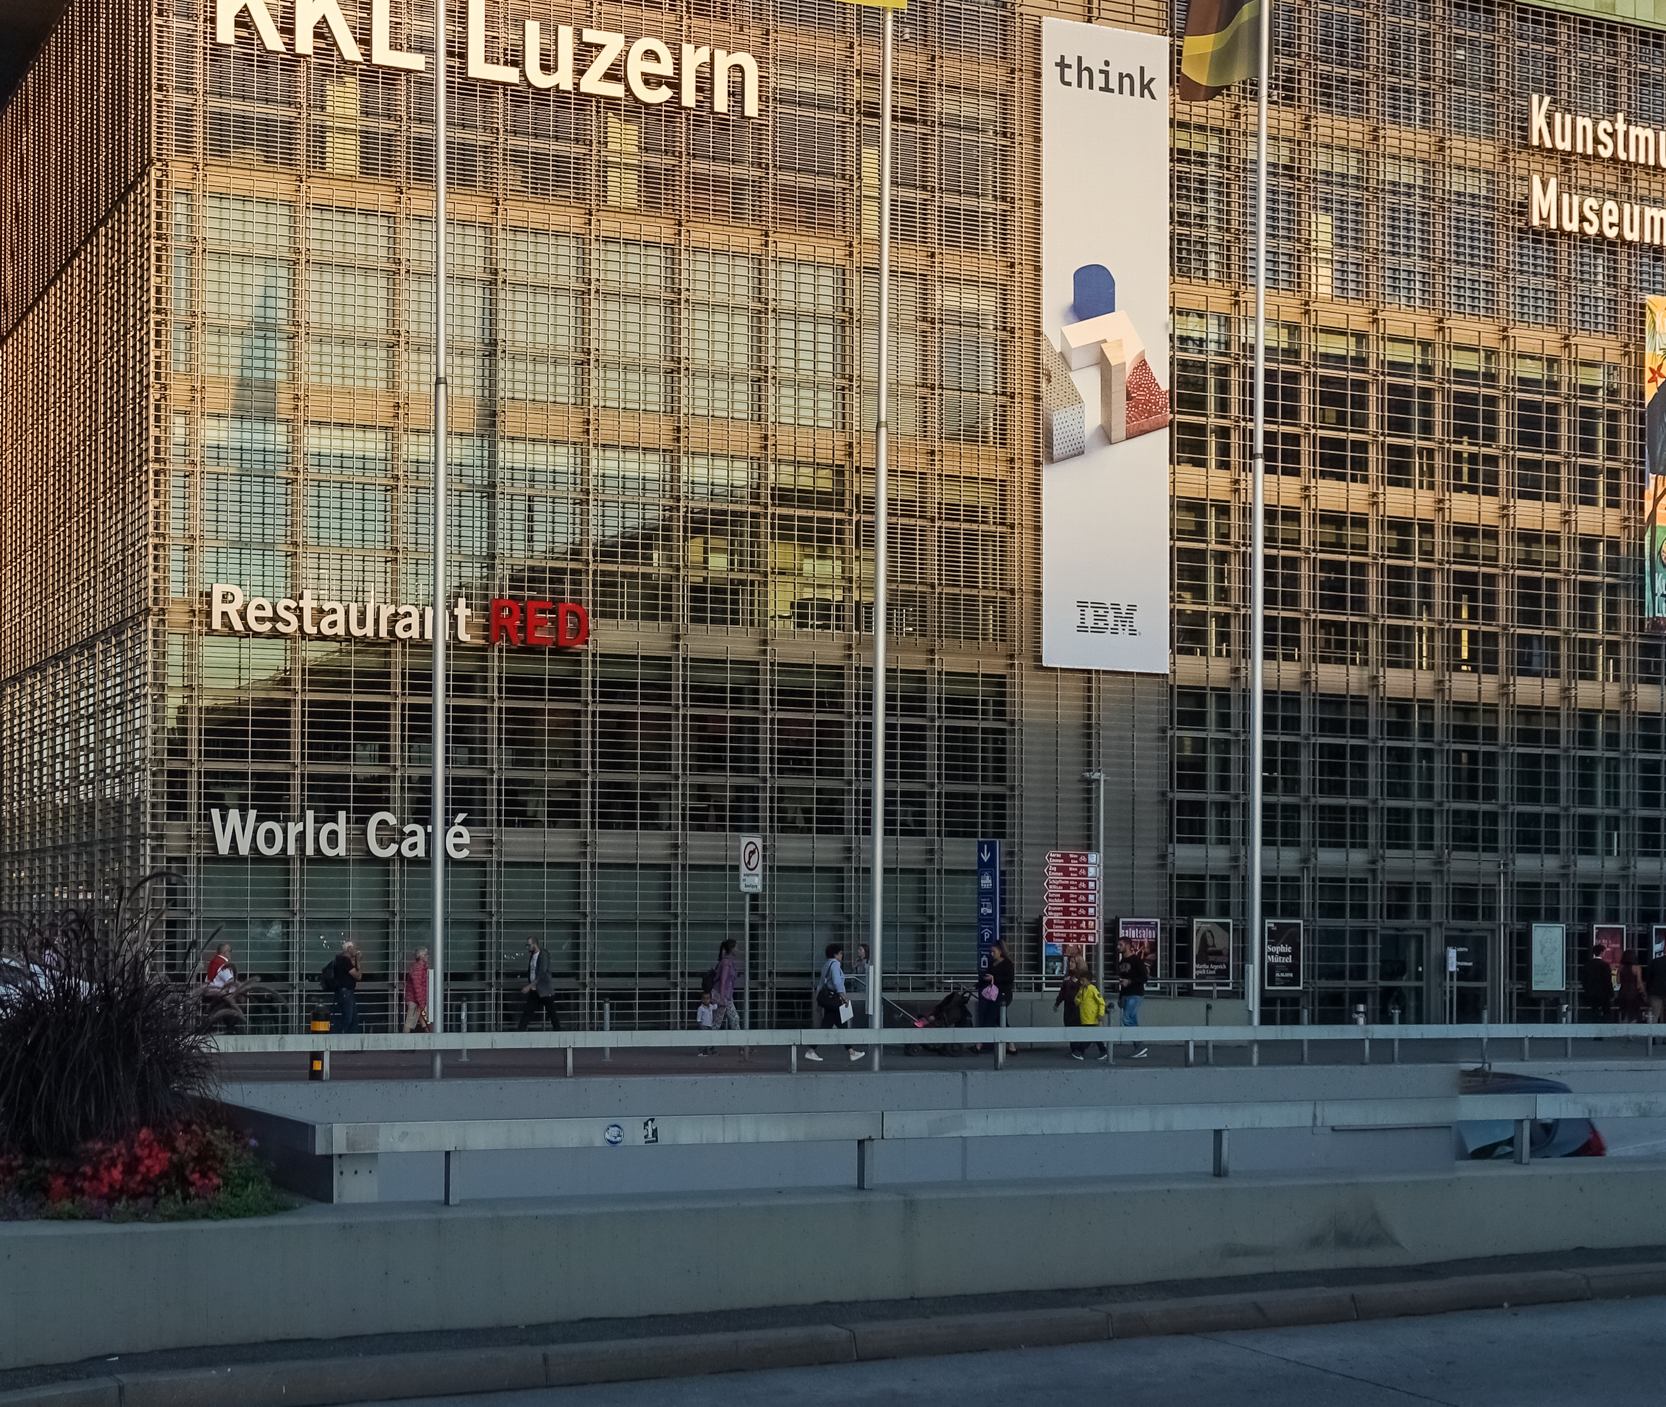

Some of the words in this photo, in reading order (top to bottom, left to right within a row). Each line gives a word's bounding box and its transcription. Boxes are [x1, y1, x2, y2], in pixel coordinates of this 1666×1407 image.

[1054, 54, 1158, 101] think
[490, 598, 590, 647] RED
[1076, 600, 1138, 636] IBM
[210, 808, 347, 857] World
[366, 810, 471, 859] Caé
[1267, 944, 1292, 954] Sophie
[1267, 954, 1292, 963] Mützel
